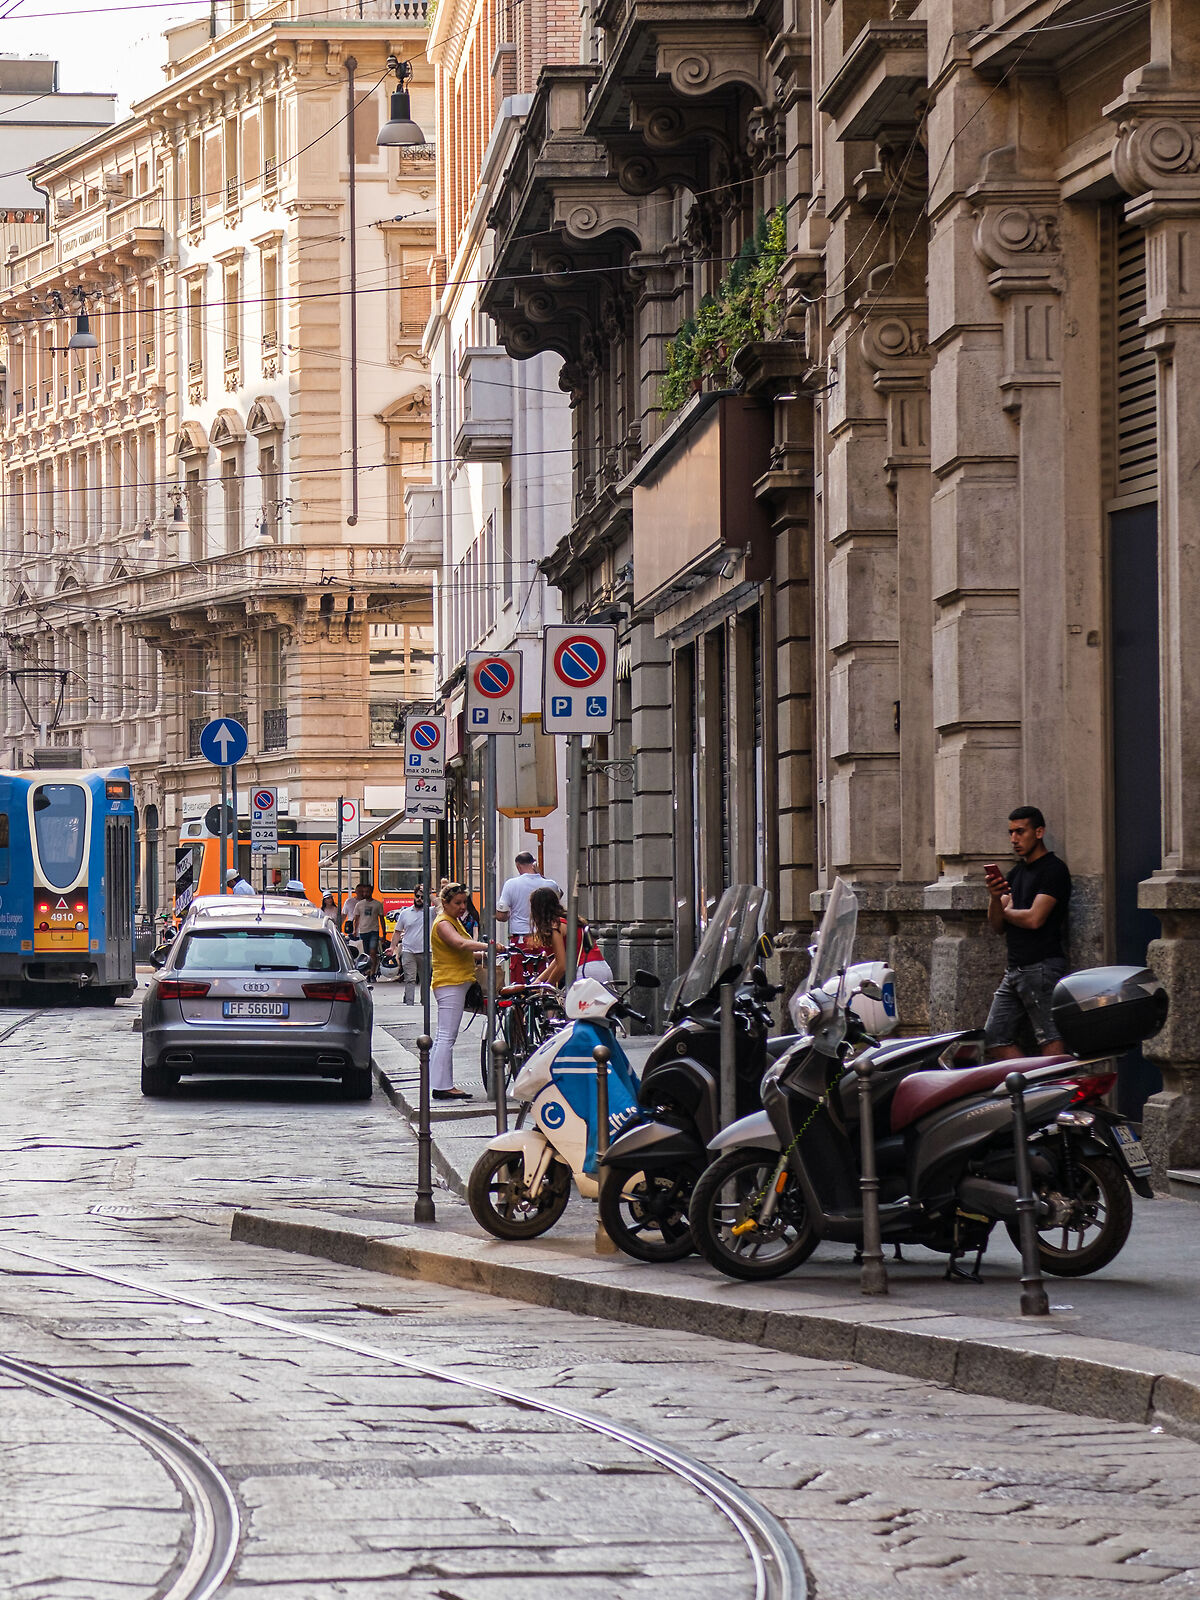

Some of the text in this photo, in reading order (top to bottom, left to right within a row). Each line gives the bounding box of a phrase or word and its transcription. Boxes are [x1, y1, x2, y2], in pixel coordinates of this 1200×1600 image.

[414, 785, 438, 793] 0-24
[50, 912, 74, 922] 4910
[230, 1003, 282, 1015] FF 566WD
